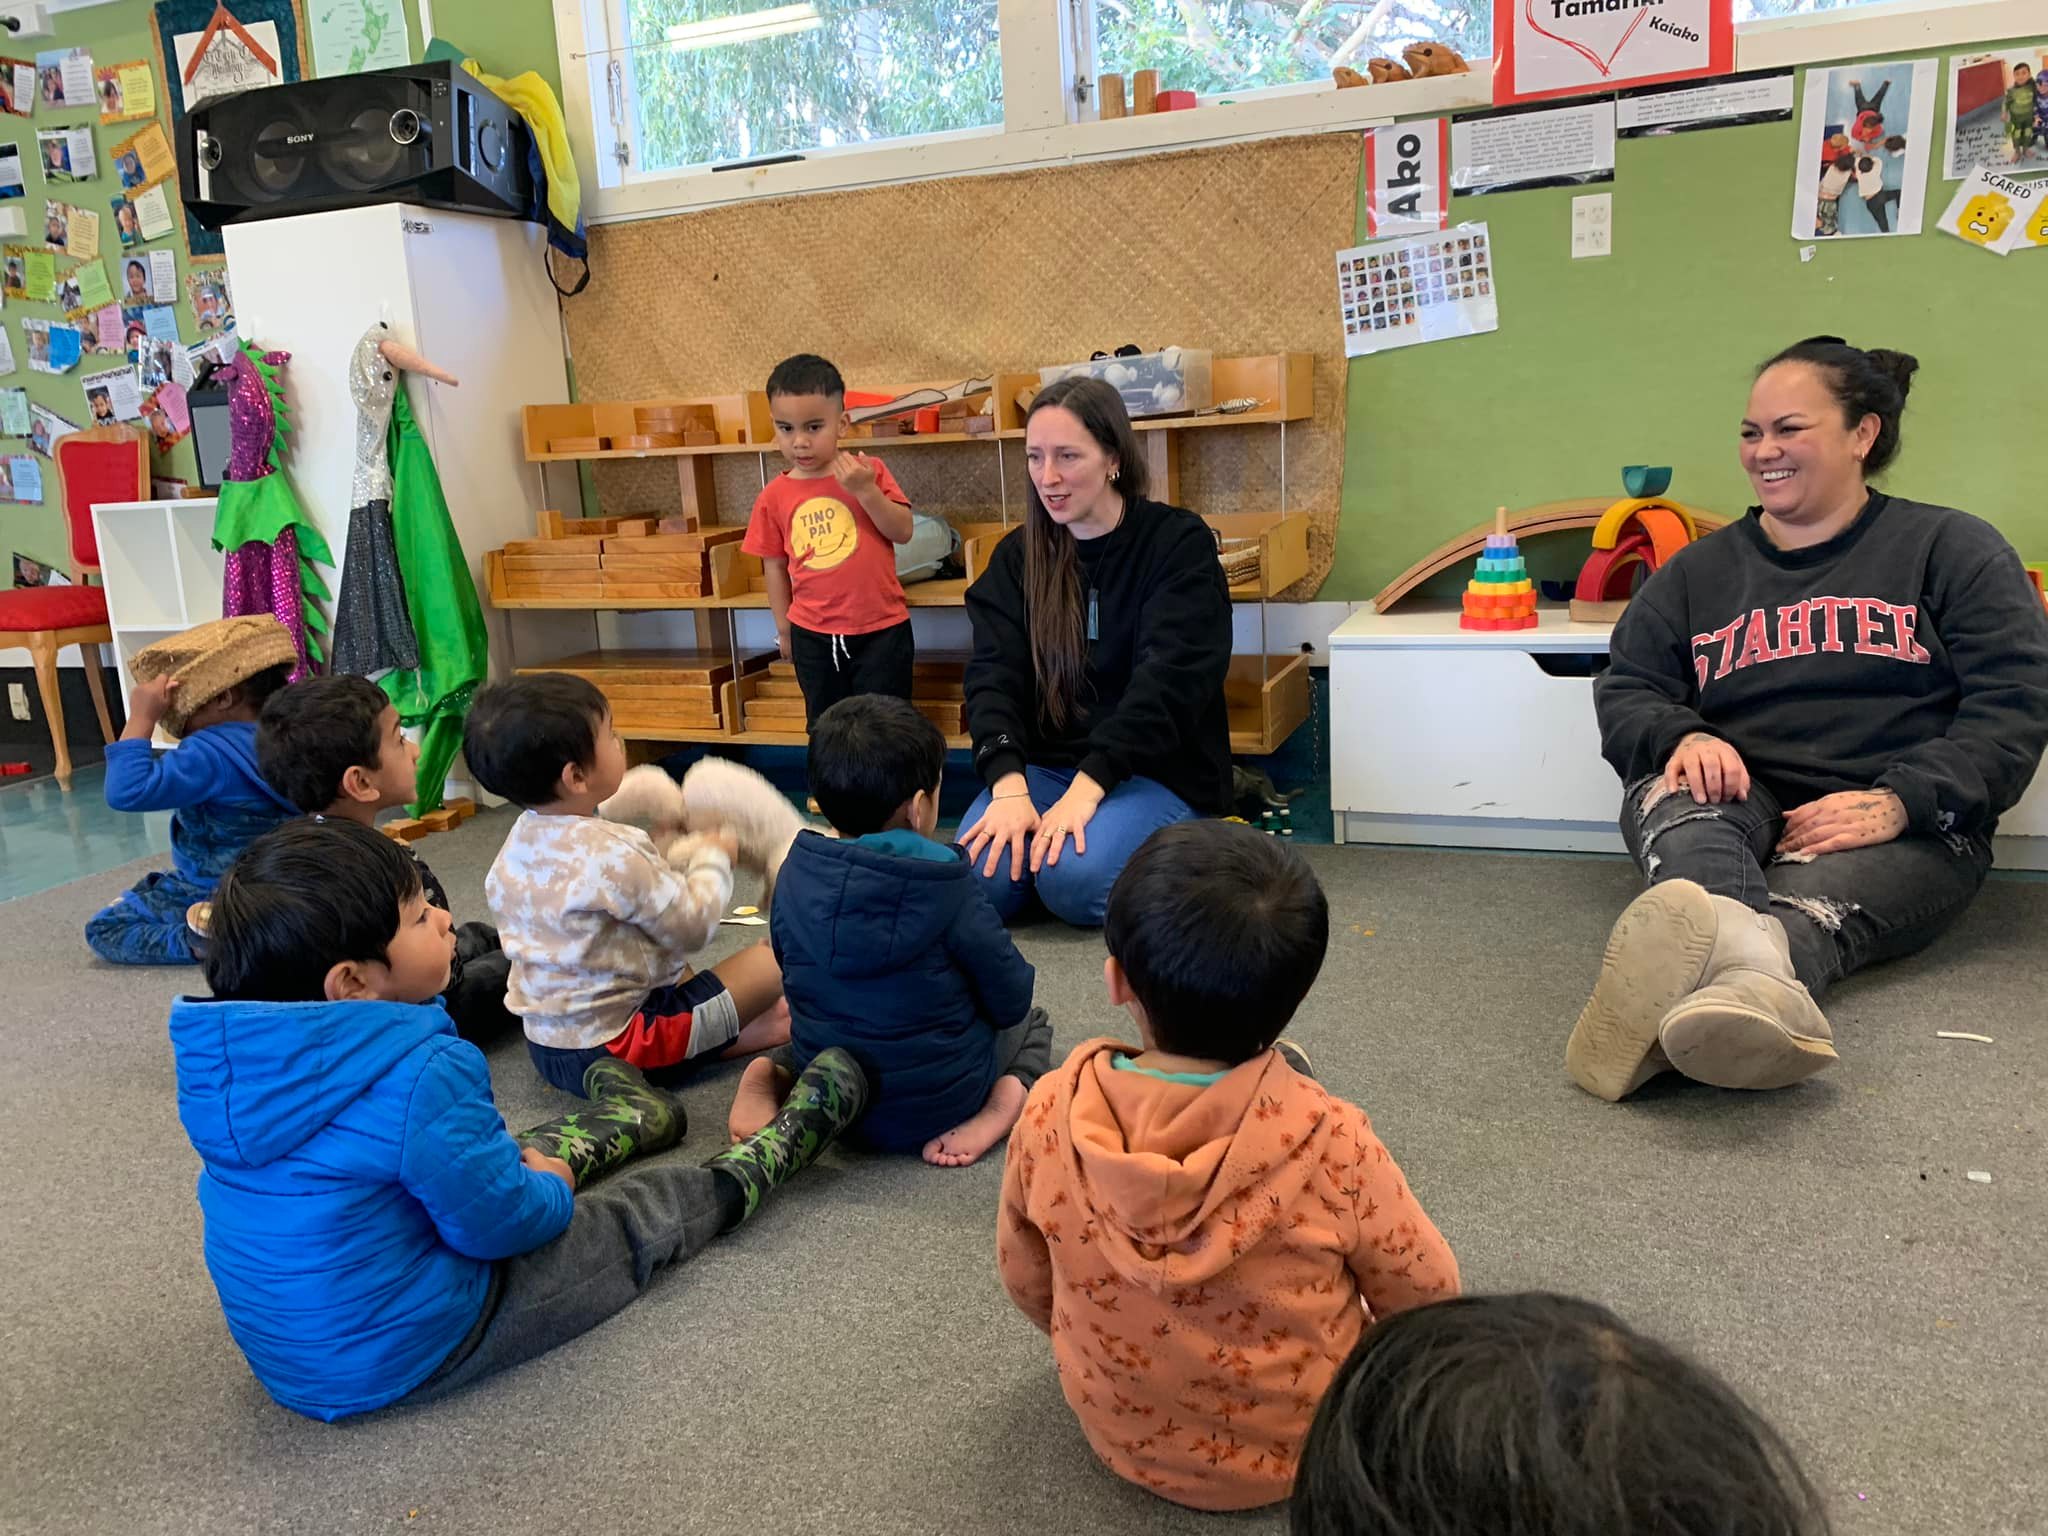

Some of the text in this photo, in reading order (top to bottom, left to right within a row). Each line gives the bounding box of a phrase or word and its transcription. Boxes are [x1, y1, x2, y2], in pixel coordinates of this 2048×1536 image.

[1551, 0, 1663, 19] Tamar
[1649, 16, 1699, 43] Kaiako
[287, 133, 313, 144] SONY
[1387, 134, 1421, 220] Ako
[1981, 171, 2031, 199] SCARED
[800, 507, 835, 527] TINO
[809, 522, 832, 539] PAI
